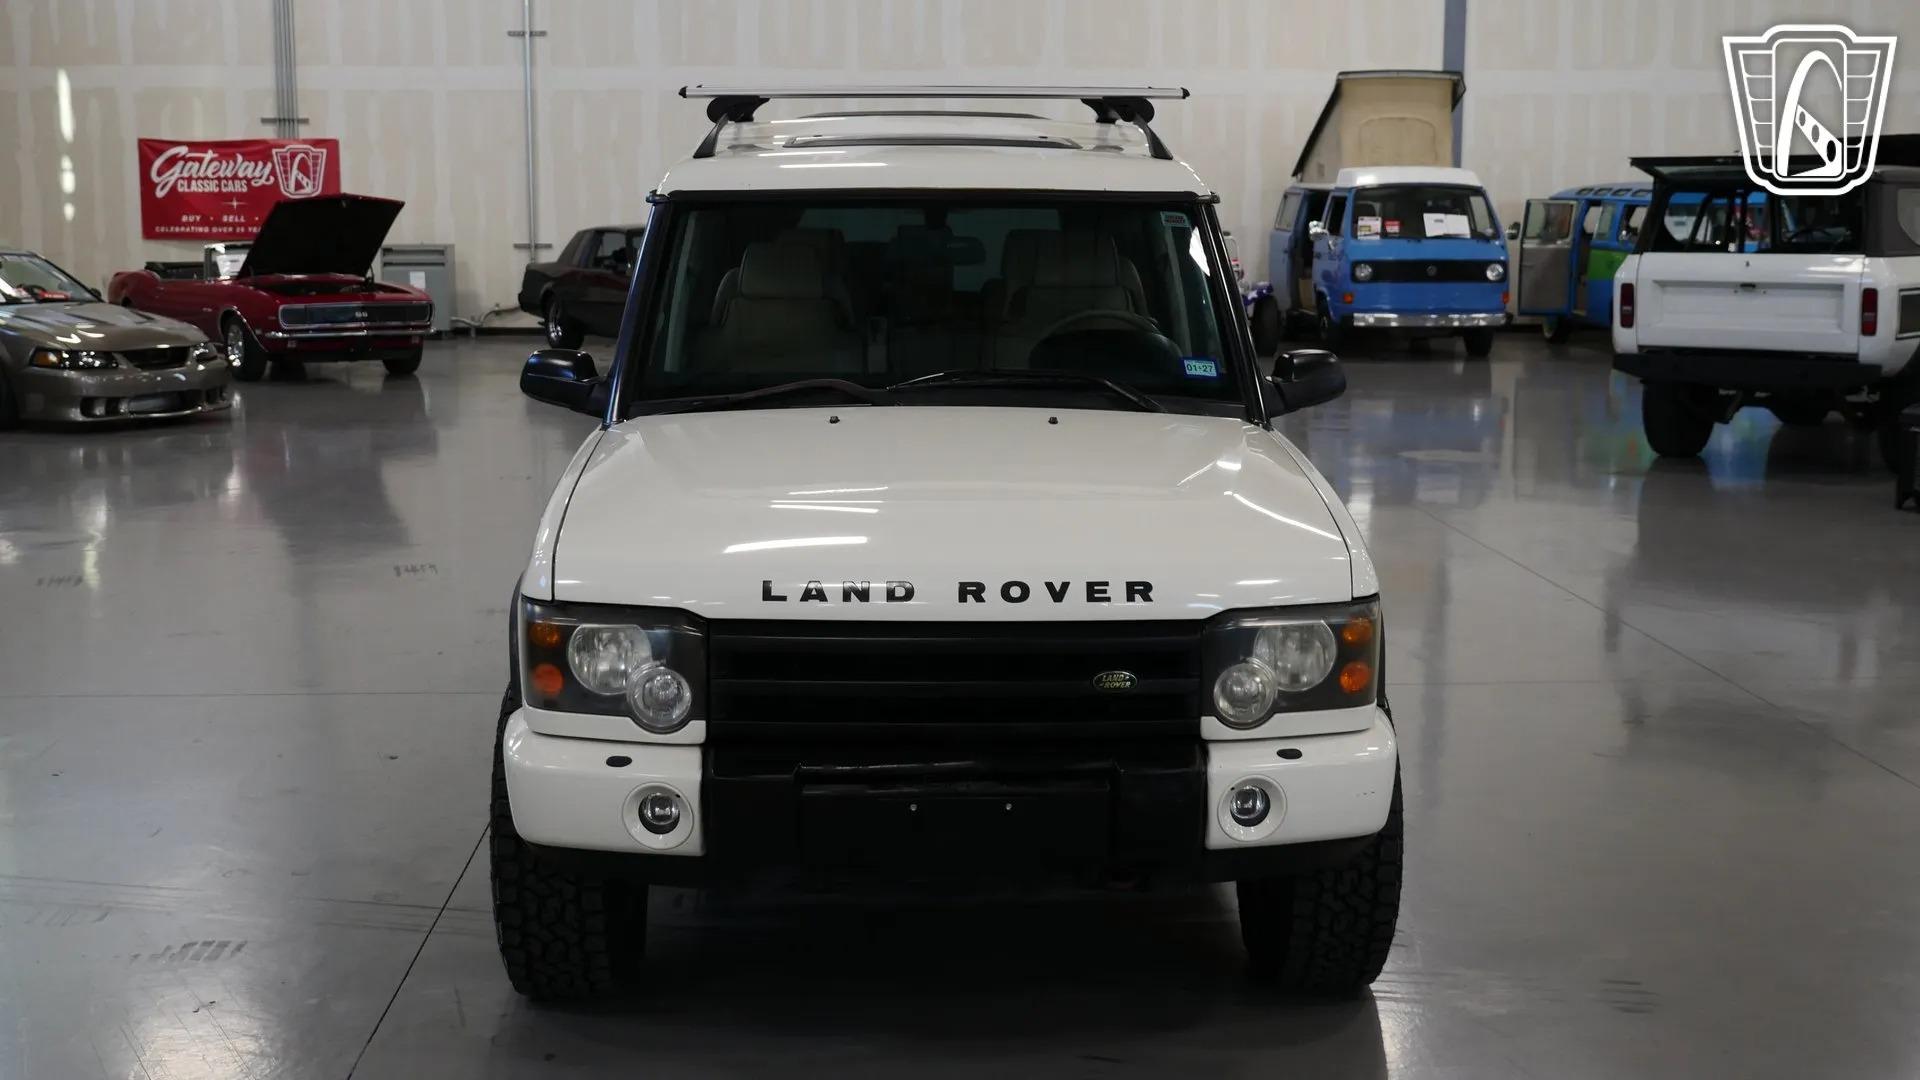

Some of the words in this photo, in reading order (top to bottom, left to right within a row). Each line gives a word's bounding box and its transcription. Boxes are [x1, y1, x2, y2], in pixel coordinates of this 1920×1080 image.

[151, 145, 274, 198] Gateway
[177, 179, 219, 192] CLASSIC
[221, 179, 248, 192] CARS
[762, 580, 915, 602] LAND
[958, 580, 1155, 603] ROVER
[1103, 681, 1131, 689] ROVER
